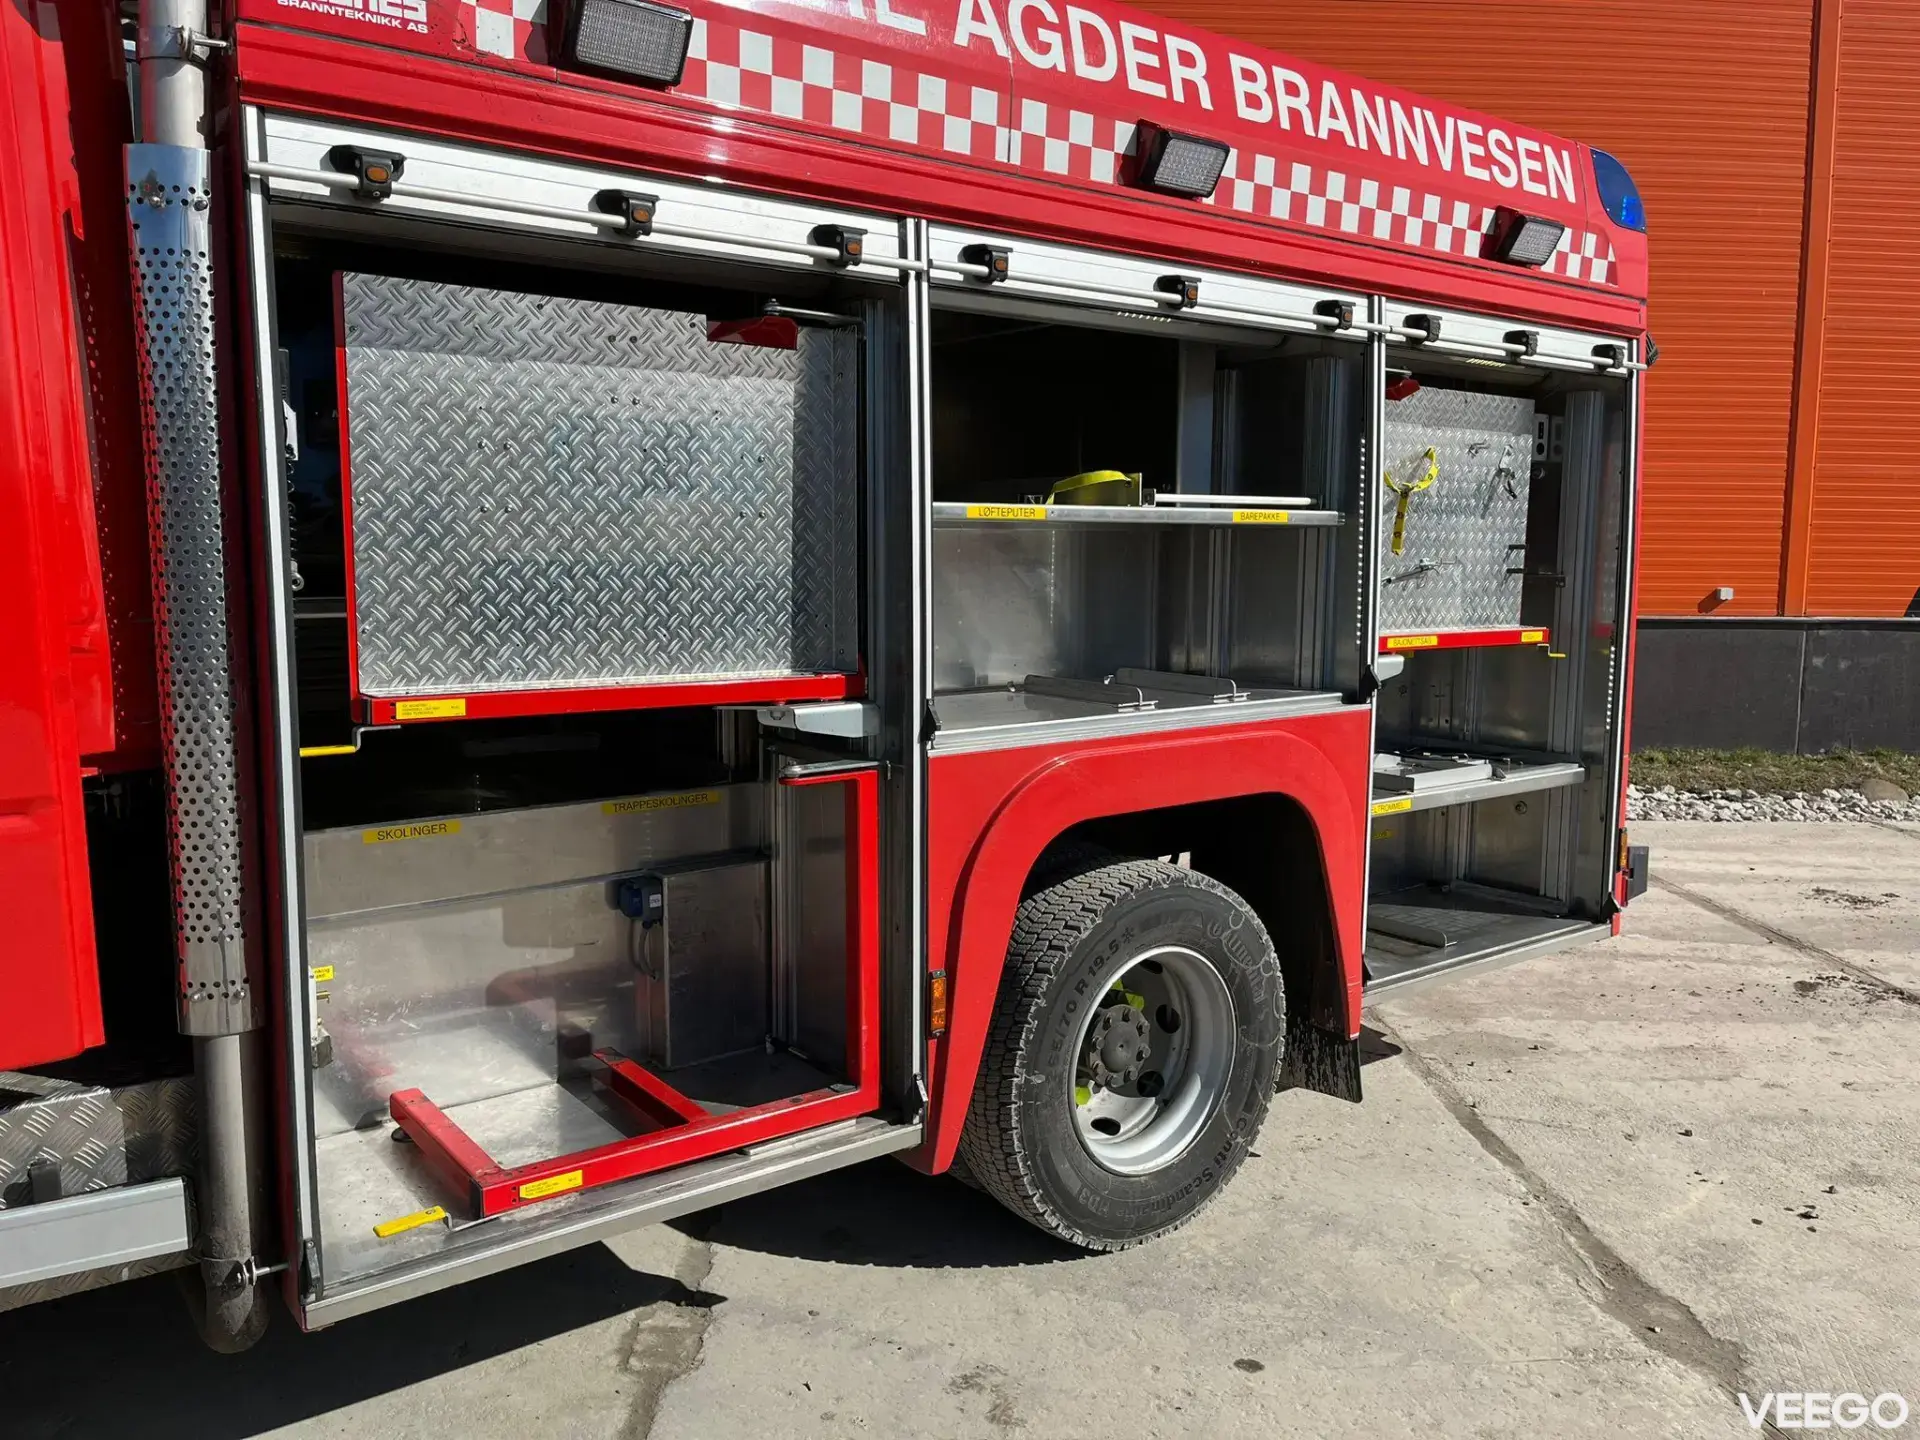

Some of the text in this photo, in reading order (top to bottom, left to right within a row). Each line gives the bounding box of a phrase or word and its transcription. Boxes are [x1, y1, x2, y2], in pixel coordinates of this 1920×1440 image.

[406, 22, 429, 34] AS
[953, 0, 1577, 203] AGDER BRANNVESEN
[978, 506, 1036, 518] LØFTEPUTER
[613, 793, 709, 813] TRAPPESKOLINGER
[377, 823, 448, 842] SKOLINGER
